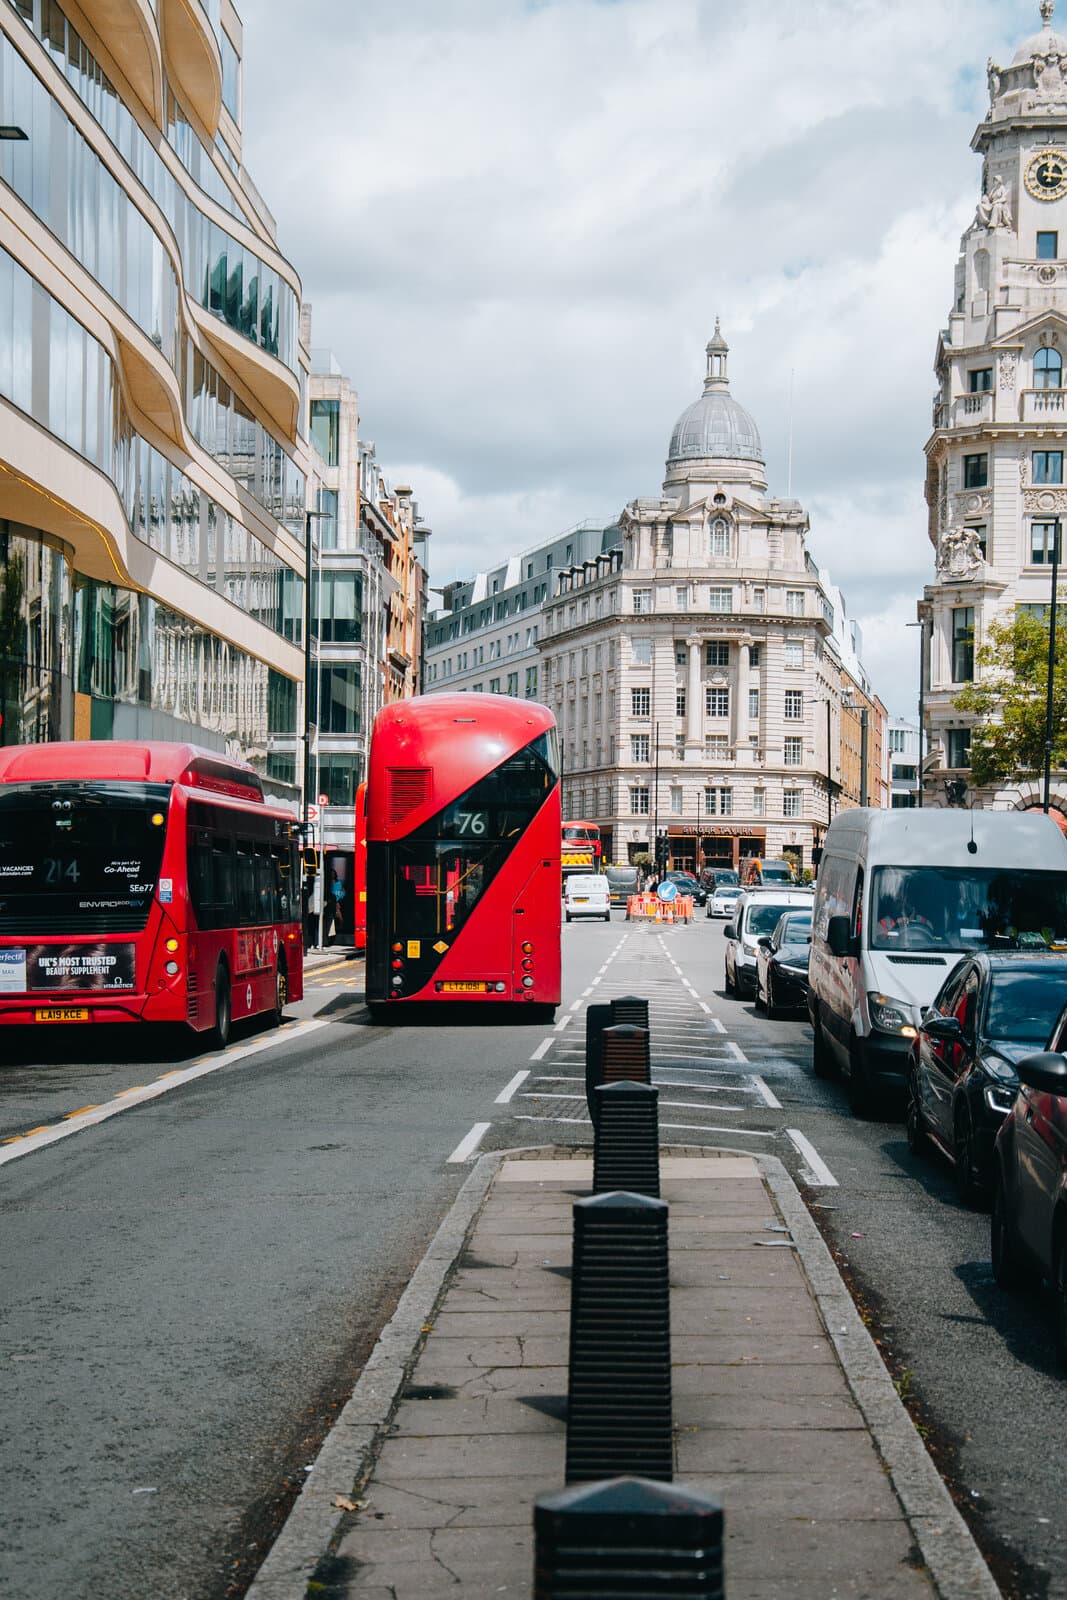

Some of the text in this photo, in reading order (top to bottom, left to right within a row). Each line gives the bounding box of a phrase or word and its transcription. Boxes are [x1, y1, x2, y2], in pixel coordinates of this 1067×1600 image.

[459, 812, 485, 834] 76
[130, 884, 154, 892] SEe77
[39, 956, 117, 967] UK'S MOST TRUSTED
[46, 966, 109, 976] BEAUTY SUPPLEMENT
[41, 1009, 81, 1019] LA19 KCE
